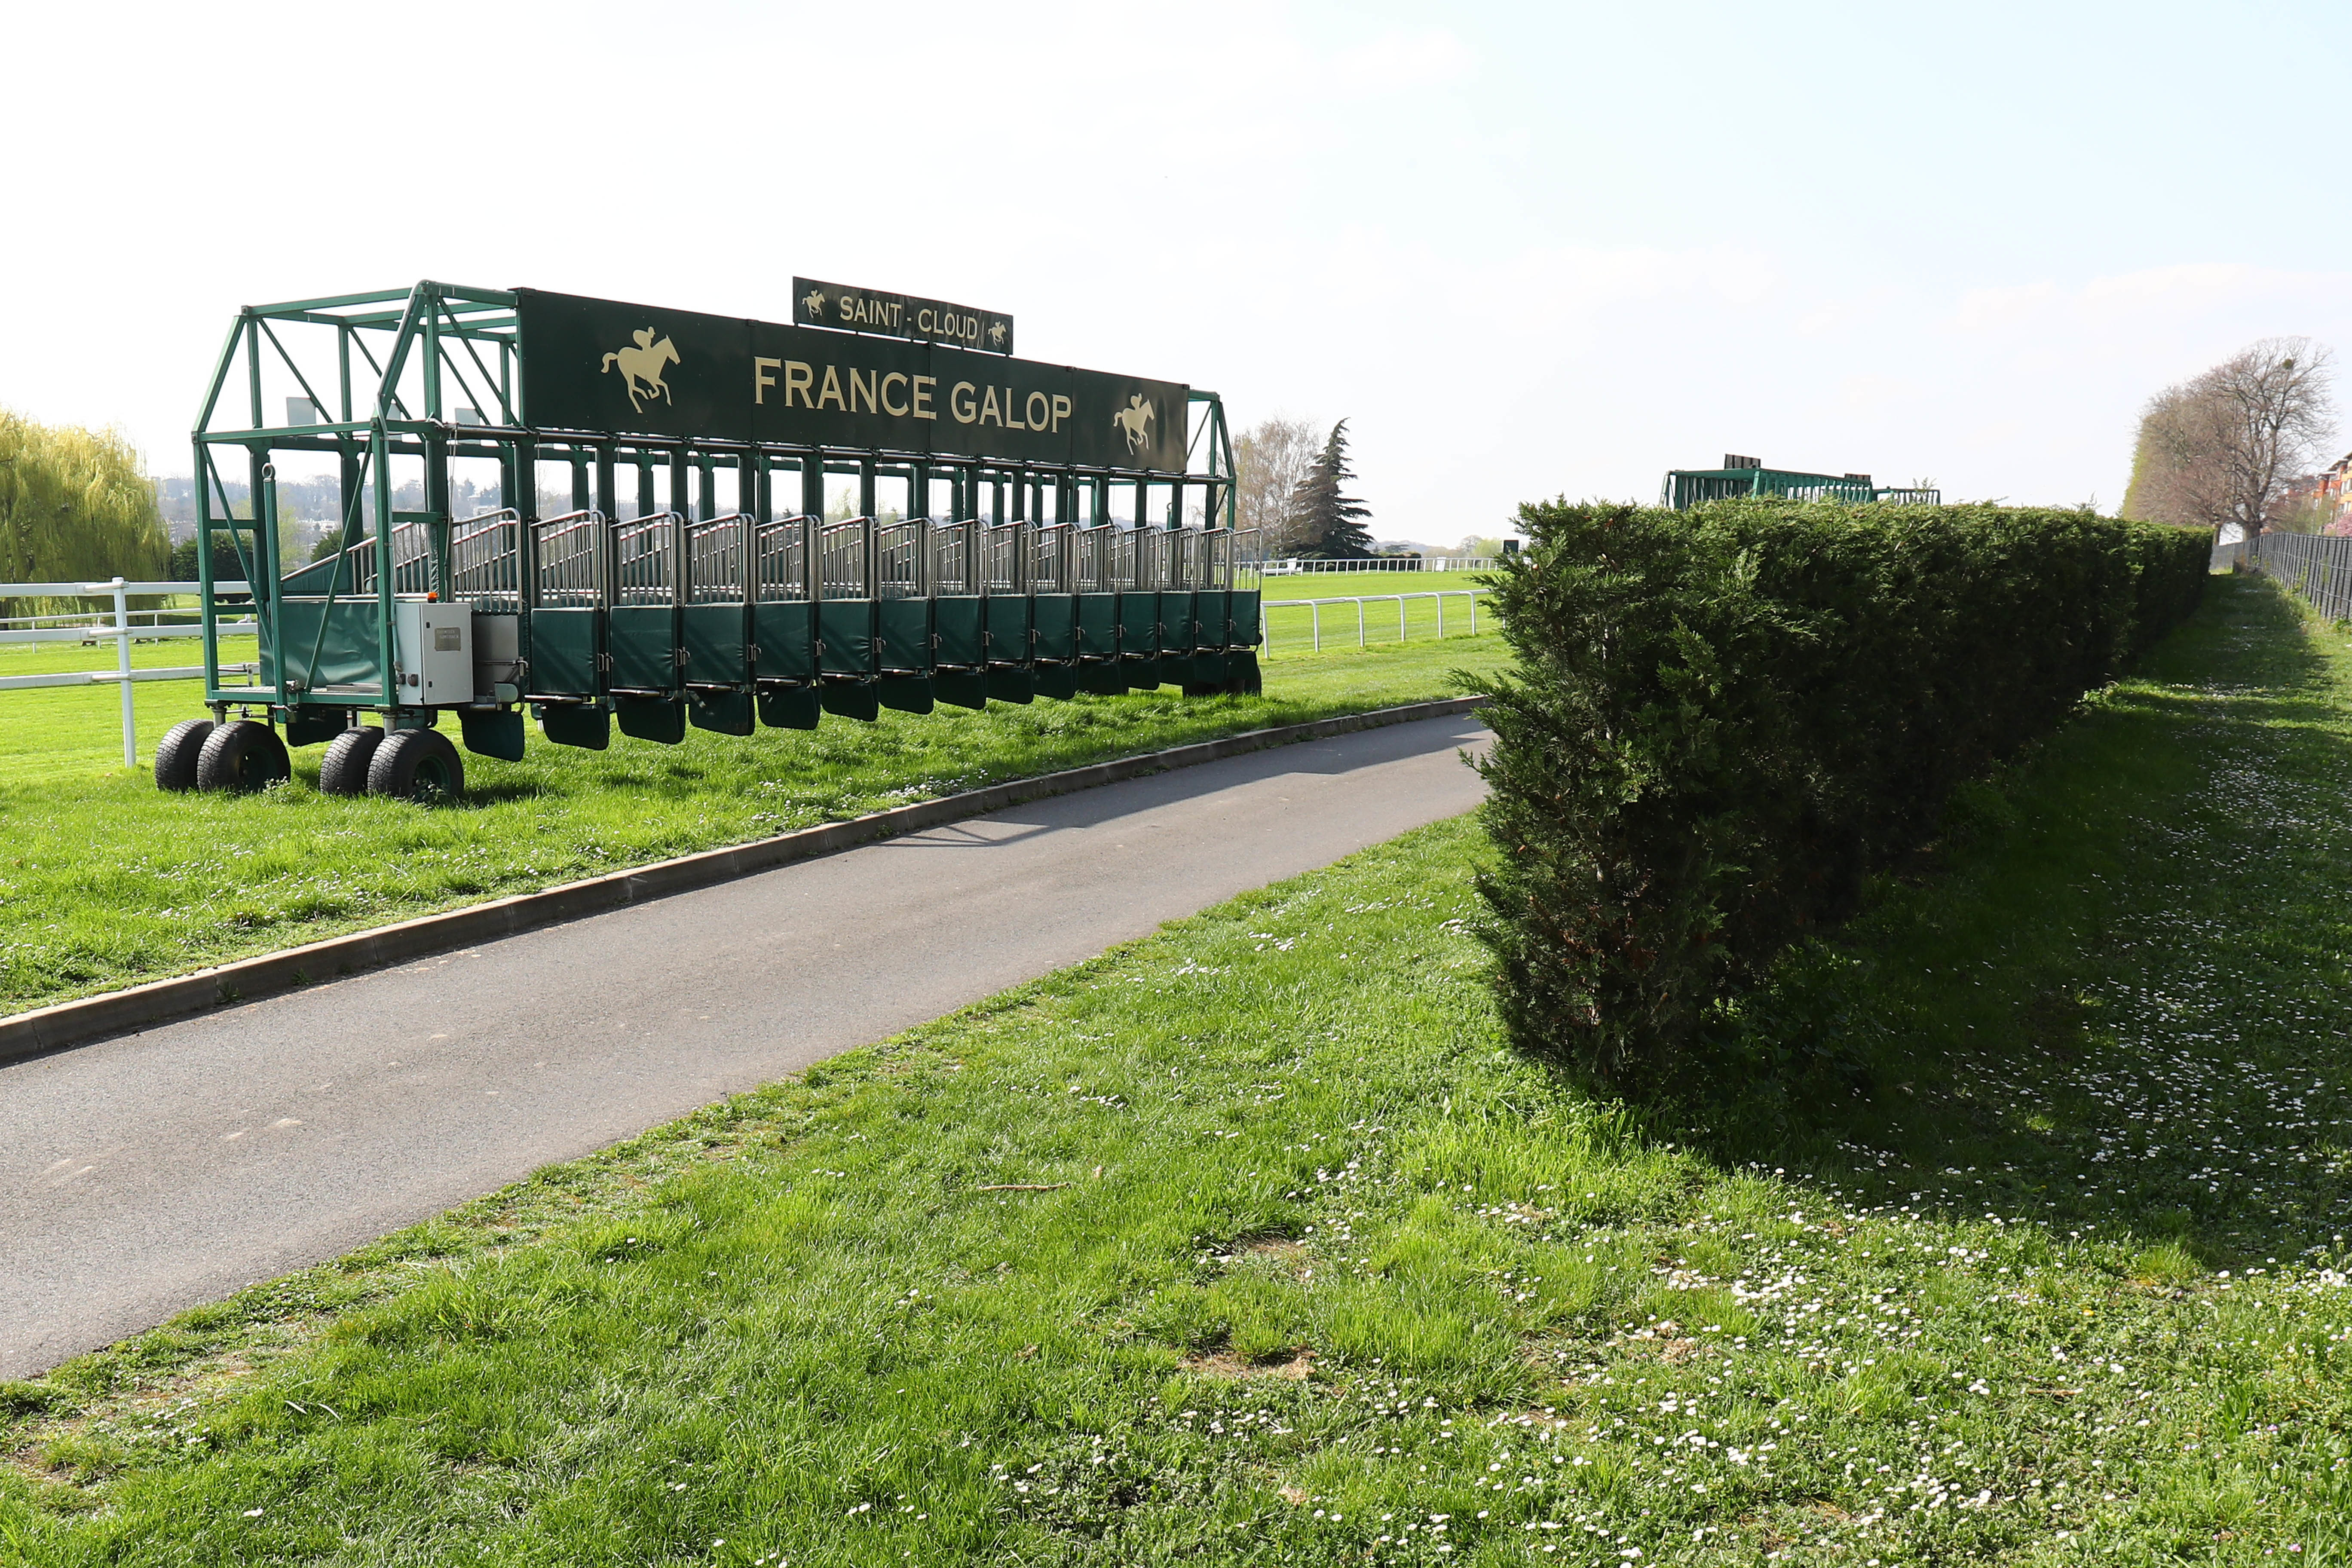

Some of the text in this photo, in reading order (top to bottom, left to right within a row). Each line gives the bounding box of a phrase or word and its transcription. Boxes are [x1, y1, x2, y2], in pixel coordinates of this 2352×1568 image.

[840, 296, 902, 327] SAINT
[918, 309, 978, 340] CLOUD
[754, 356, 1072, 433] FRANCE GALOP
